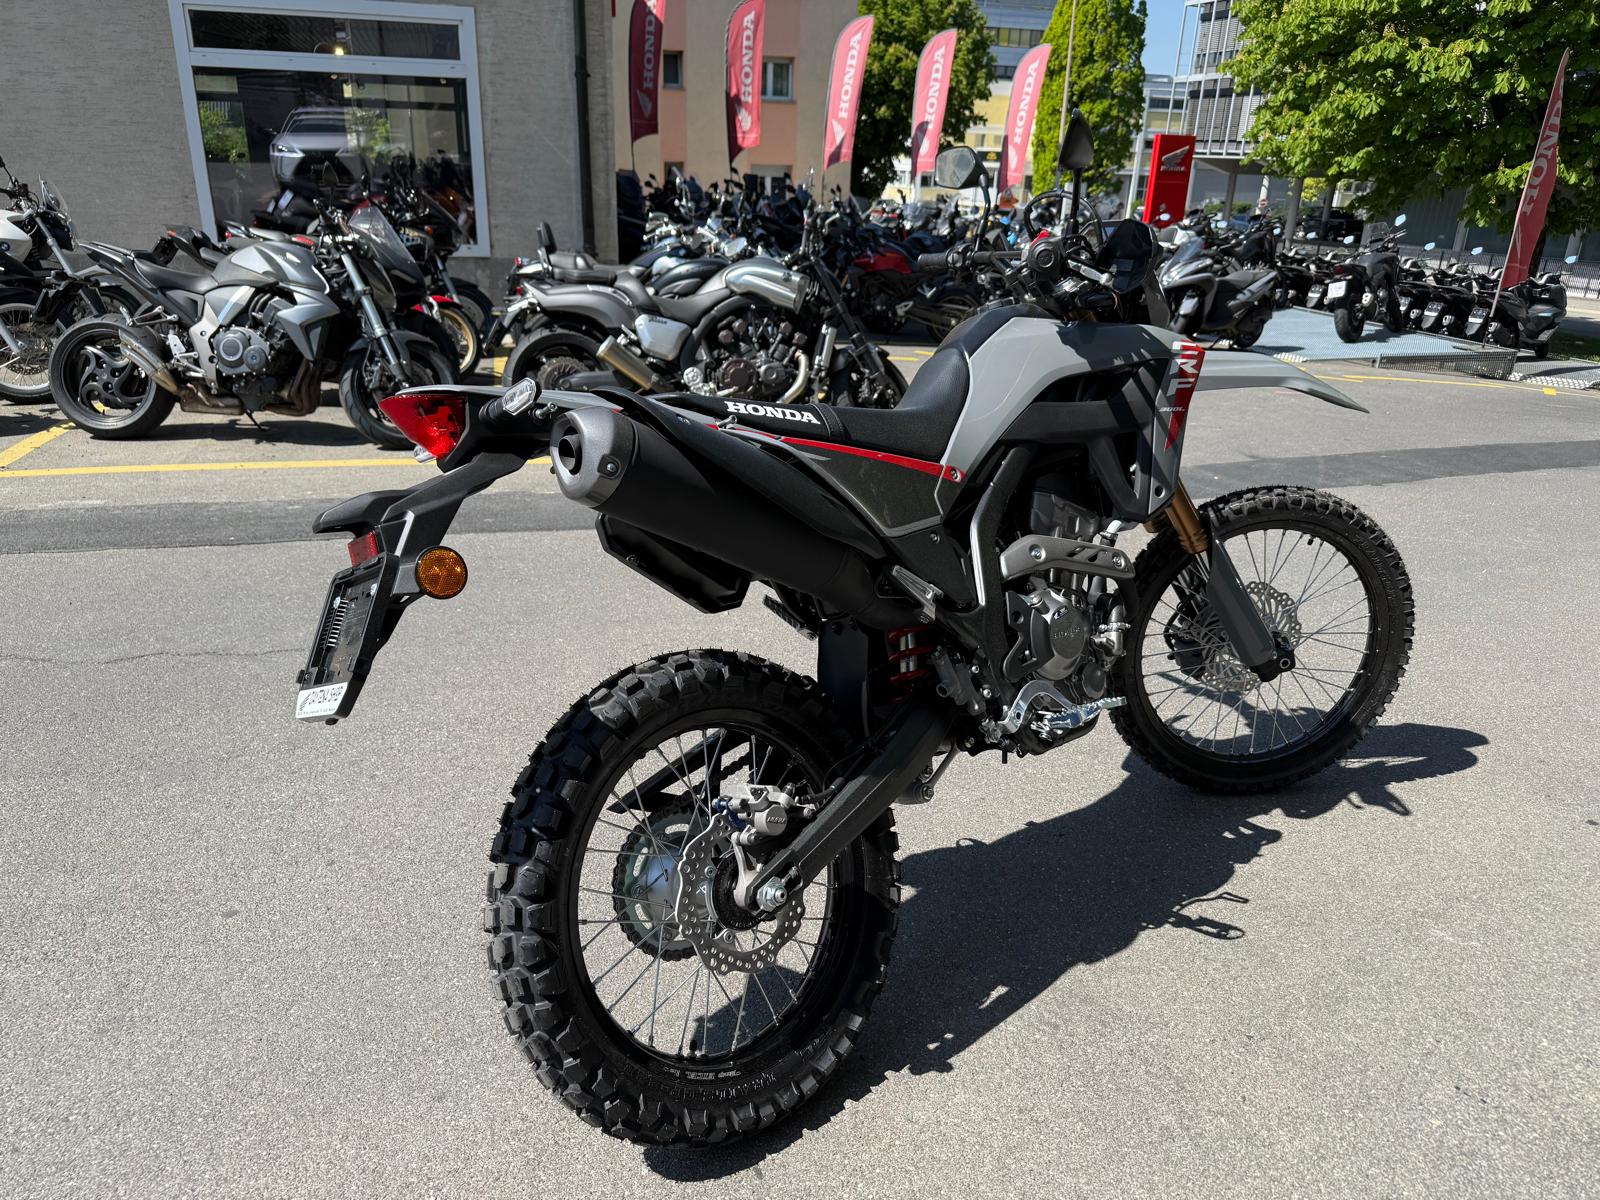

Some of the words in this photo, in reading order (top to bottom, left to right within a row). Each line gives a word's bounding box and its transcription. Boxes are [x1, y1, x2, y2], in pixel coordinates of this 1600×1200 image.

[741, 10, 755, 104] HONDA
[838, 31, 863, 120] HONDA
[924, 46, 946, 131] HONDA
[1013, 59, 1040, 145] HONDA
[1522, 78, 1564, 215] HOND
[1166, 341, 1200, 397] CRF
[724, 401, 821, 425] HONDA
